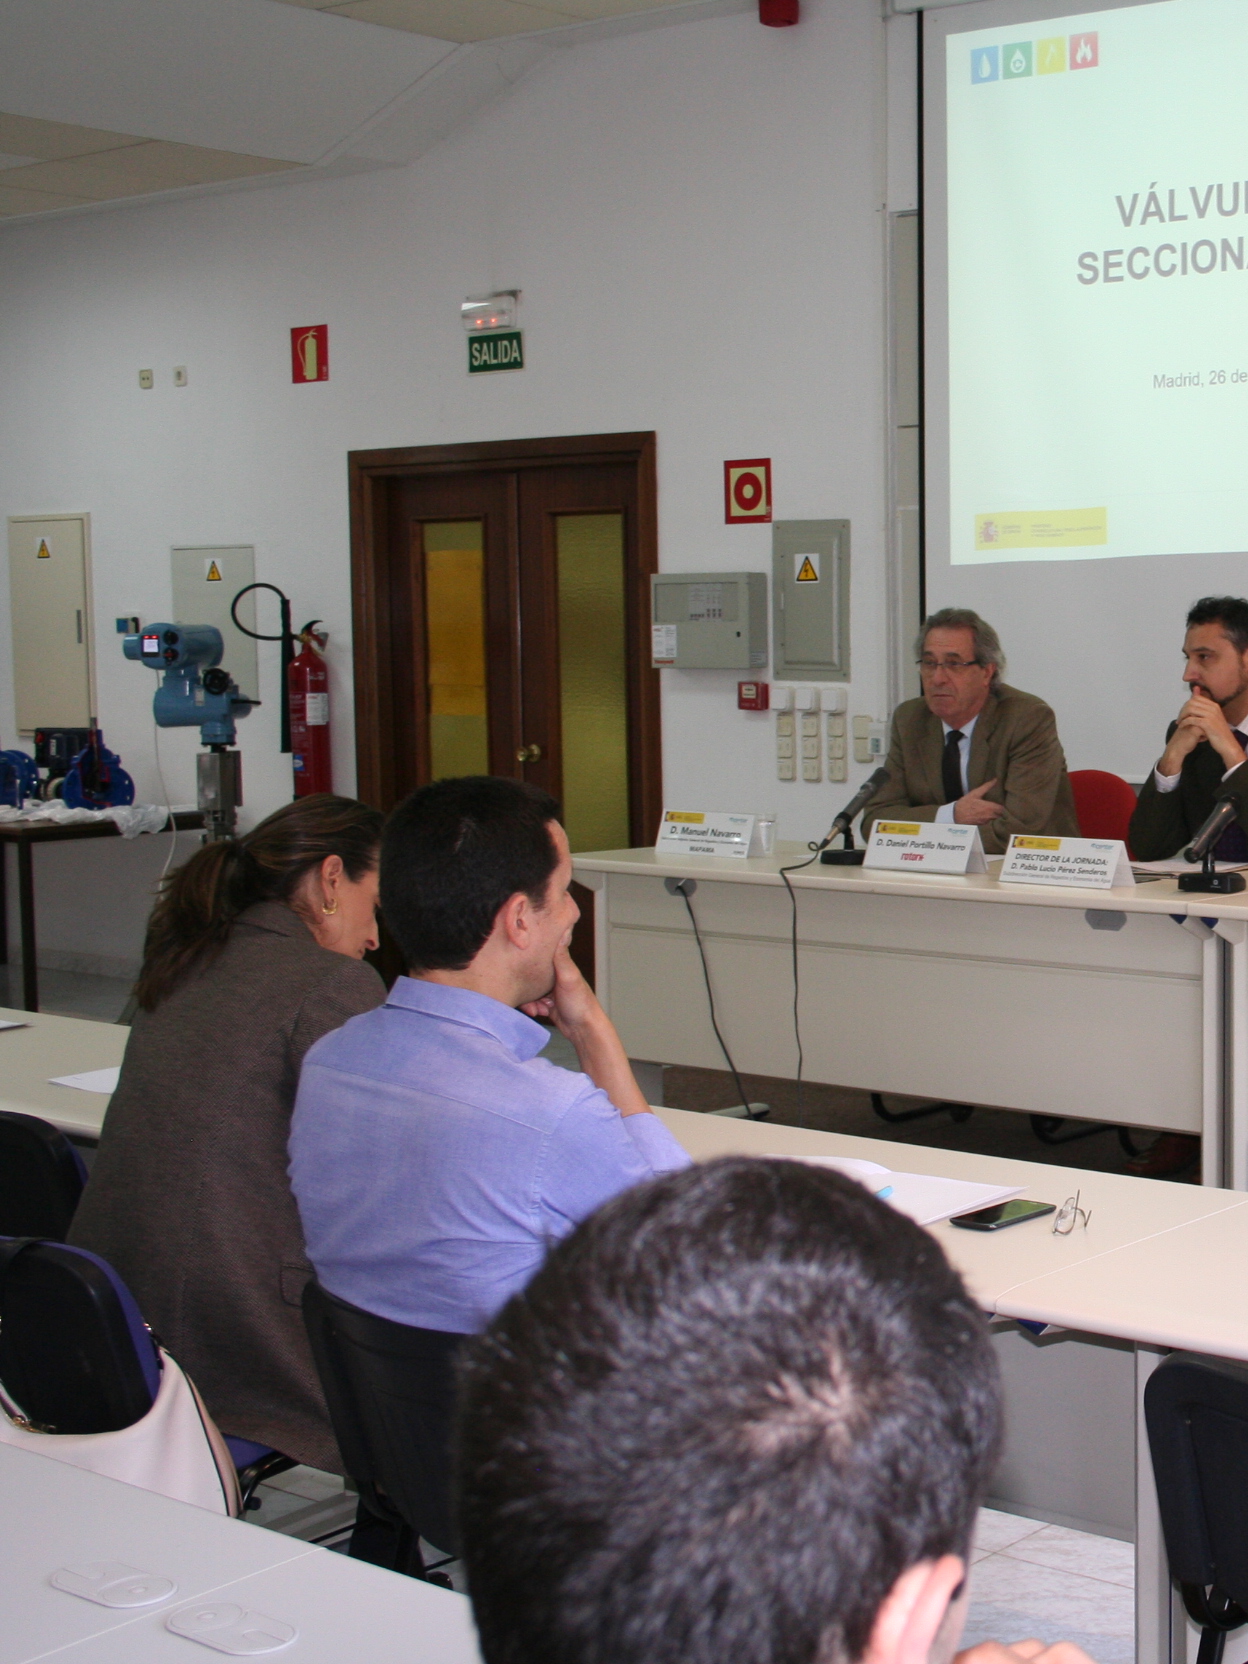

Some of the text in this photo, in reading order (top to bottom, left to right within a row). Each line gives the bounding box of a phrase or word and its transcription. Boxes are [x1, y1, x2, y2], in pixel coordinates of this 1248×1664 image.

[471, 339, 521, 366] SALIDA
[1153, 372, 1204, 389] Madrid,
[1208, 369, 1226, 385] 26
[1231, 369, 1248, 383] de
[670, 826, 742, 838] D. Manuel Navarro
[886, 840, 908, 848] Daniel
[909, 841, 935, 849] Portillo
[936, 843, 966, 851] Navarro
[1015, 853, 1048, 861] DIRECTOR
[1019, 863, 1038, 871] Pablo
[1057, 866, 1076, 874] Pérez
[1077, 867, 1108, 876] Senderos
